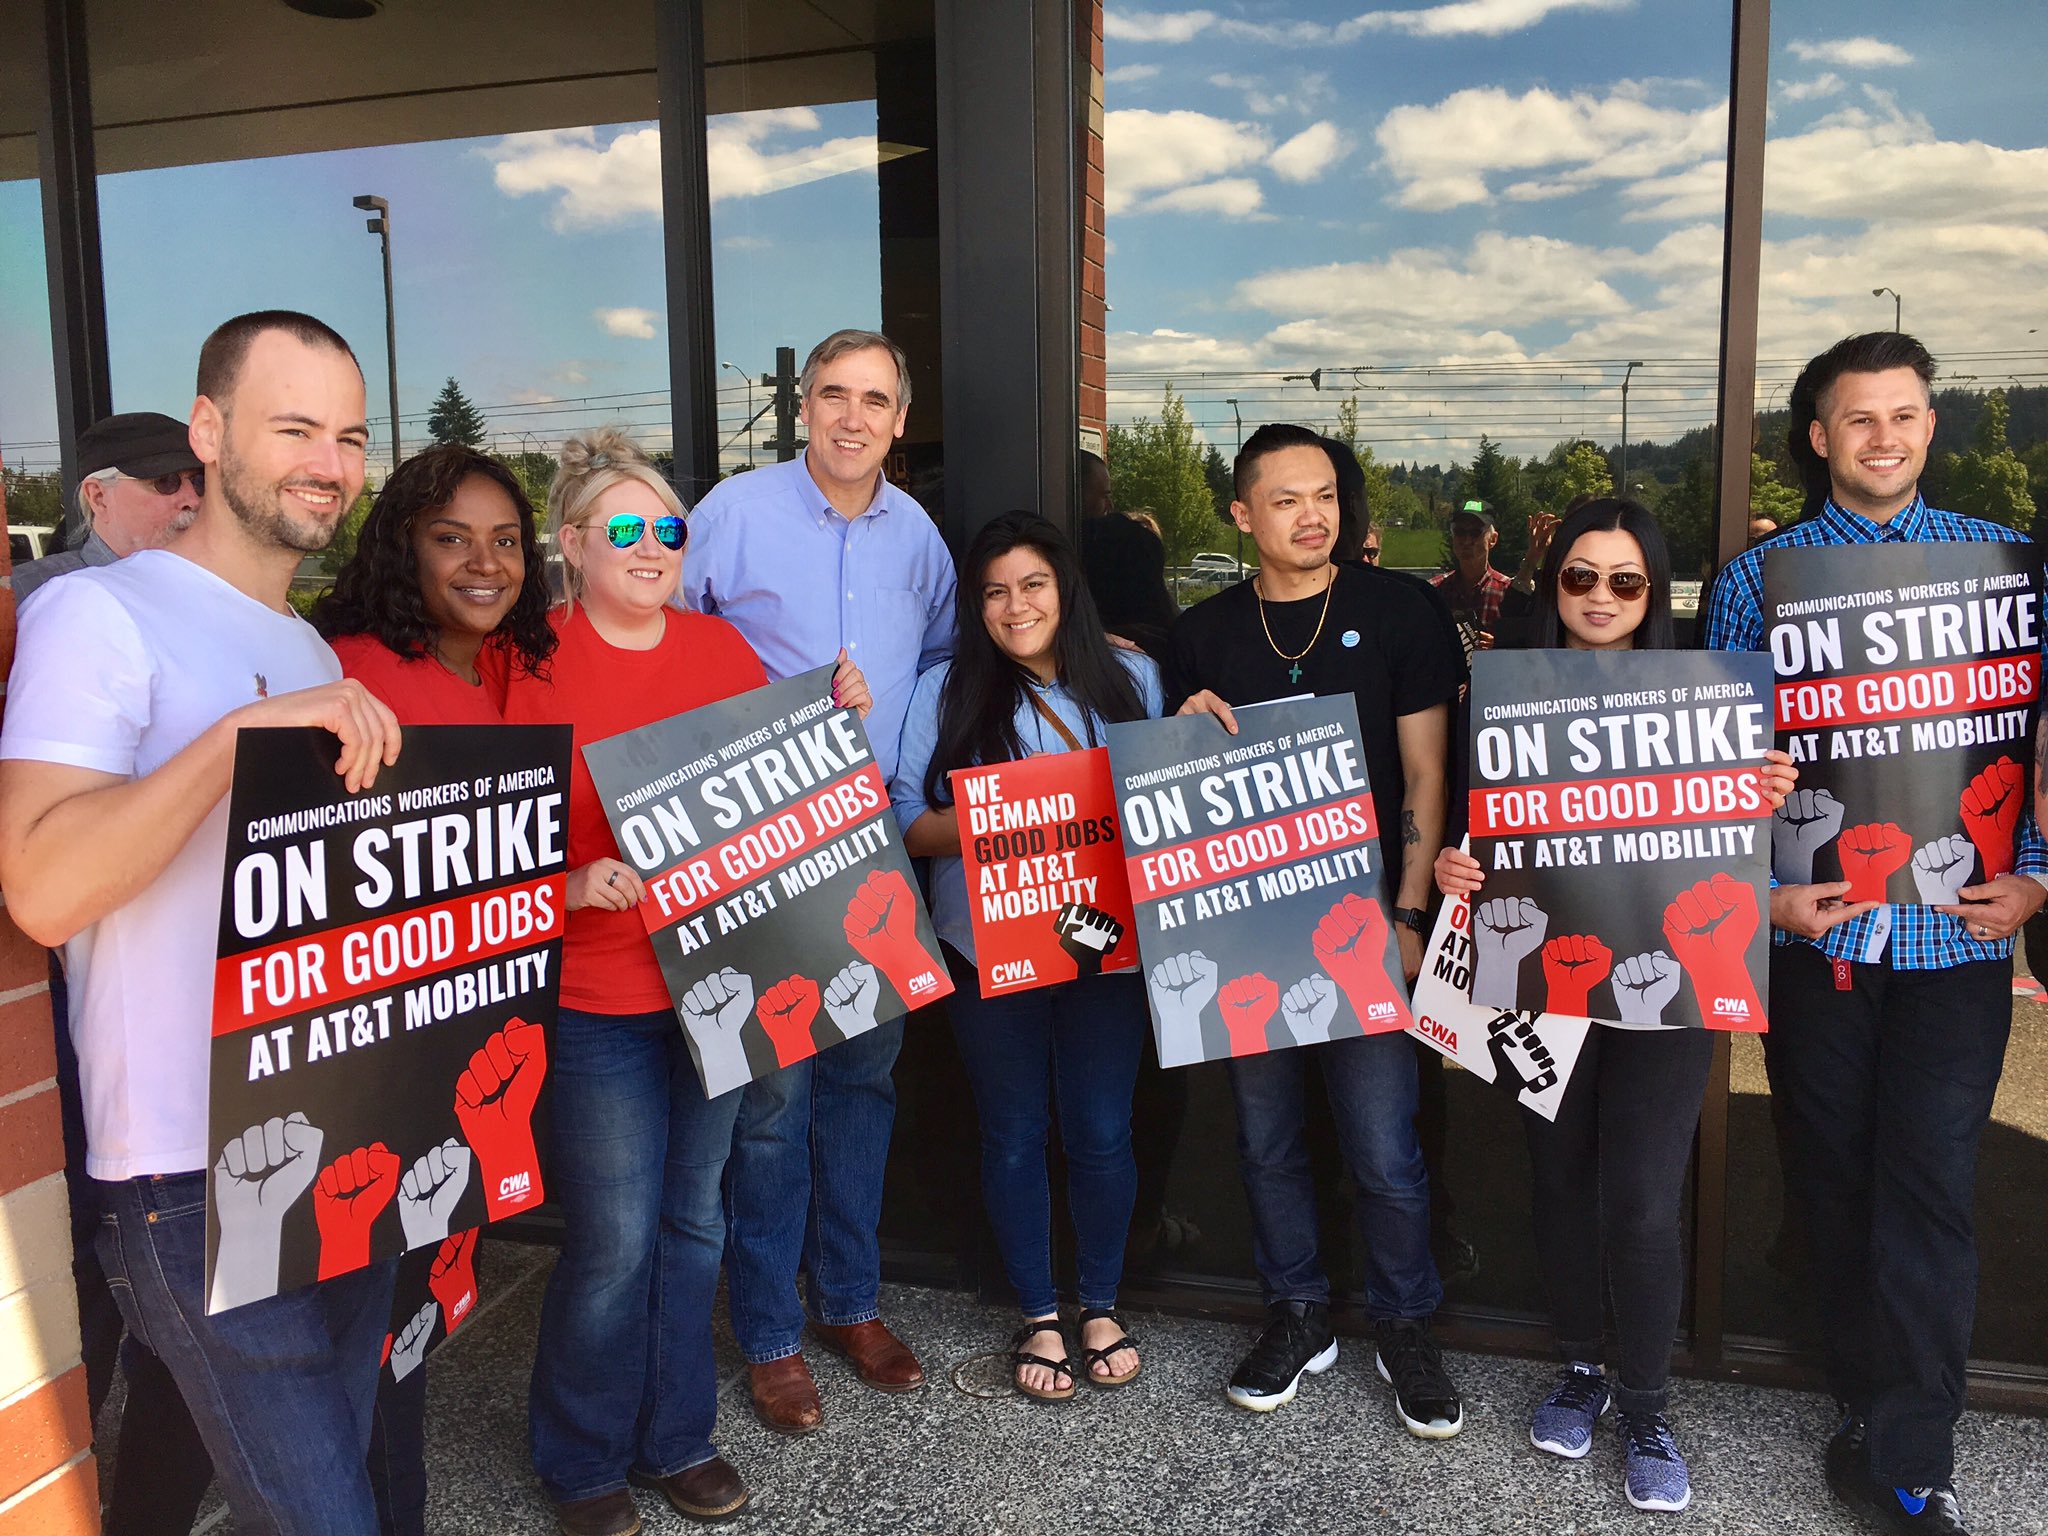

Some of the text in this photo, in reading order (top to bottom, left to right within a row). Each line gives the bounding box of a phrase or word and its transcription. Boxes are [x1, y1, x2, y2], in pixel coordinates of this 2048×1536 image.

[1776, 572, 2030, 618] COMMUNICATIONS WORKERS OF AMERICA
[1770, 594, 2037, 675] ON STRIKE
[1483, 681, 1756, 721] COMMUNICATIONS WORKERS OF AMERICA
[1780, 661, 2031, 722] FOR GOOD JOBS
[615, 694, 835, 813] COMMUNICATIONS WORKERS OF AMERICA
[1125, 722, 1345, 791] COMMUNICATIONS WORKERS OF AMERICA
[1478, 704, 1768, 780] ON STRIKE
[1789, 710, 2027, 763] AT AT&T MOBILITY
[247, 765, 555, 843] COMMUNICATIONS WORKERS OF AMERICA
[621, 711, 868, 869] ON STRIKE
[964, 773, 1003, 806] WE
[970, 794, 1075, 835] DEMAND
[1124, 739, 1365, 845] ON STRIKE
[1486, 774, 1759, 827] FOR GOOD JOBS
[235, 793, 562, 937] ON STRIKE
[652, 775, 878, 916] FOR GOOD JOBS
[975, 816, 1115, 864] GOOD JOBS
[1142, 803, 1367, 891] FOR GOOD JOBS
[1494, 825, 1755, 869] AT AT&T MOBILITY
[677, 819, 889, 955] AT AT&T MOBILITY
[981, 851, 1075, 894] AT AT&T
[1158, 847, 1370, 930] AT AT&T MOBILITY
[982, 877, 1096, 922] MOBILITY
[242, 885, 554, 1014] FOR GOOD JOBS
[991, 959, 1036, 983] CWA
[1440, 930, 1471, 961] AT
[909, 971, 936, 991] CWA
[1714, 997, 1749, 1013] CWA
[249, 950, 548, 1080] AT AT&T MOBILITY
[1367, 1001, 1396, 1017] CWA
[1419, 1015, 1458, 1050] CWA
[500, 1171, 530, 1195] CWA
[453, 1290, 471, 1315] CWA
